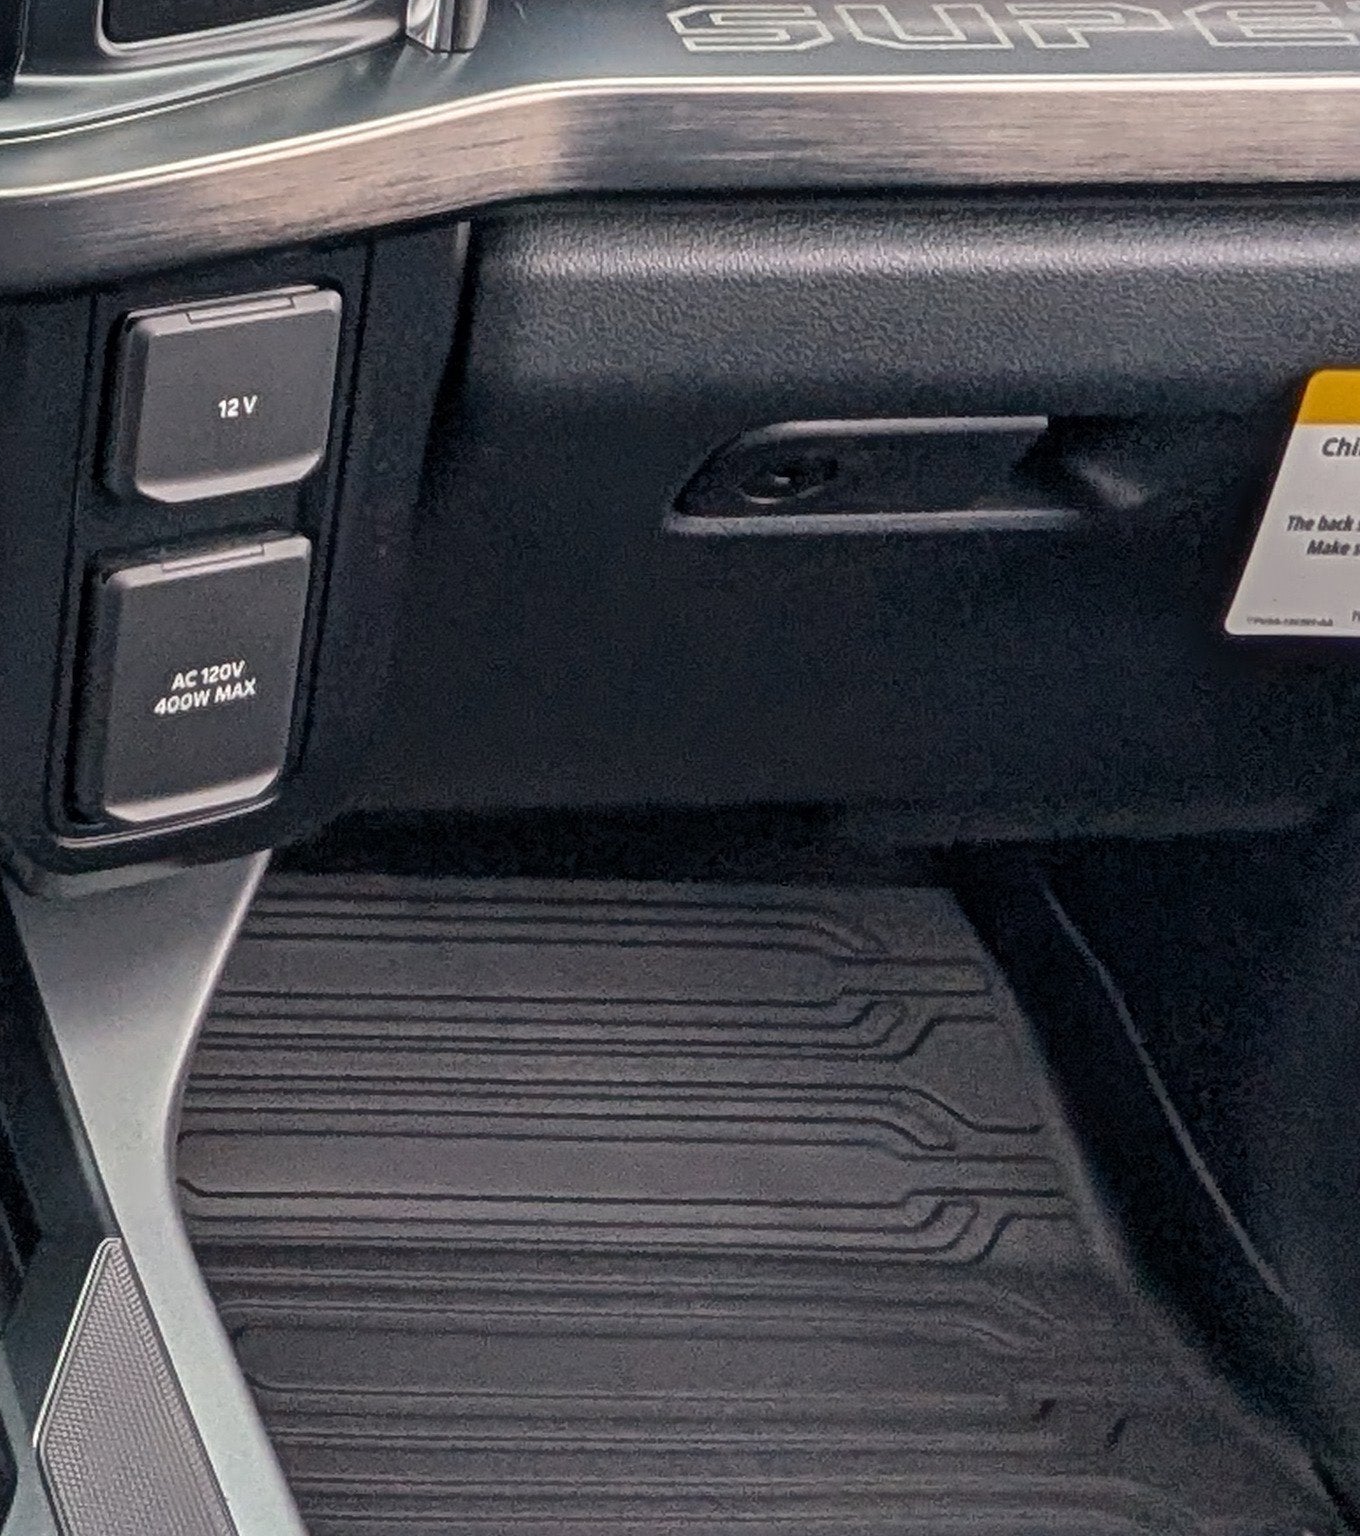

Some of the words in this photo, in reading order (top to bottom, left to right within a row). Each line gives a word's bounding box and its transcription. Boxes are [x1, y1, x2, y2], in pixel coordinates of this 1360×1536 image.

[667, 2, 1360, 52] SUPE
[218, 398, 239, 418] 12
[242, 396, 258, 415] V
[172, 670, 197, 690] AC
[202, 660, 245, 687] 120V
[154, 691, 210, 716] 400W
[215, 678, 256, 705] MAX
